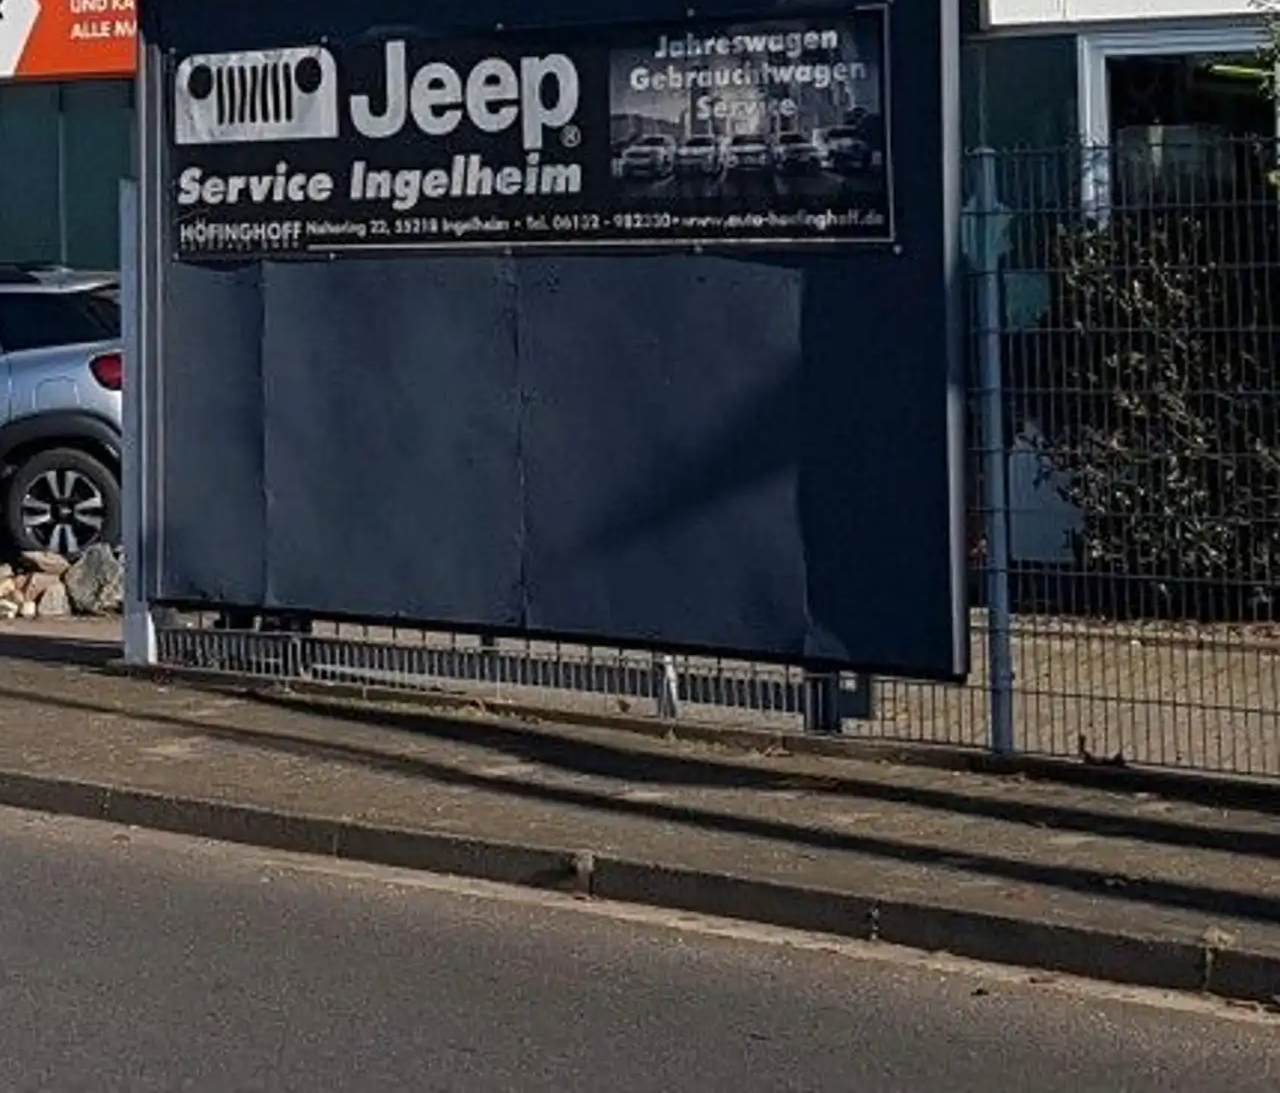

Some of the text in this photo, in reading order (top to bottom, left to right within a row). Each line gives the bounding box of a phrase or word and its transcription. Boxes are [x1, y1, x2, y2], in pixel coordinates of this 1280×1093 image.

[69, 21, 111, 40] ALLE
[654, 29, 839, 58] Jahreswagen
[629, 61, 867, 91] Gebrauchtwagen
[349, 39, 581, 150] Jeep
[696, 94, 797, 120] Service
[177, 152, 583, 211] Service Ingelheim
[180, 217, 303, 244] HÖFINGHOFF
